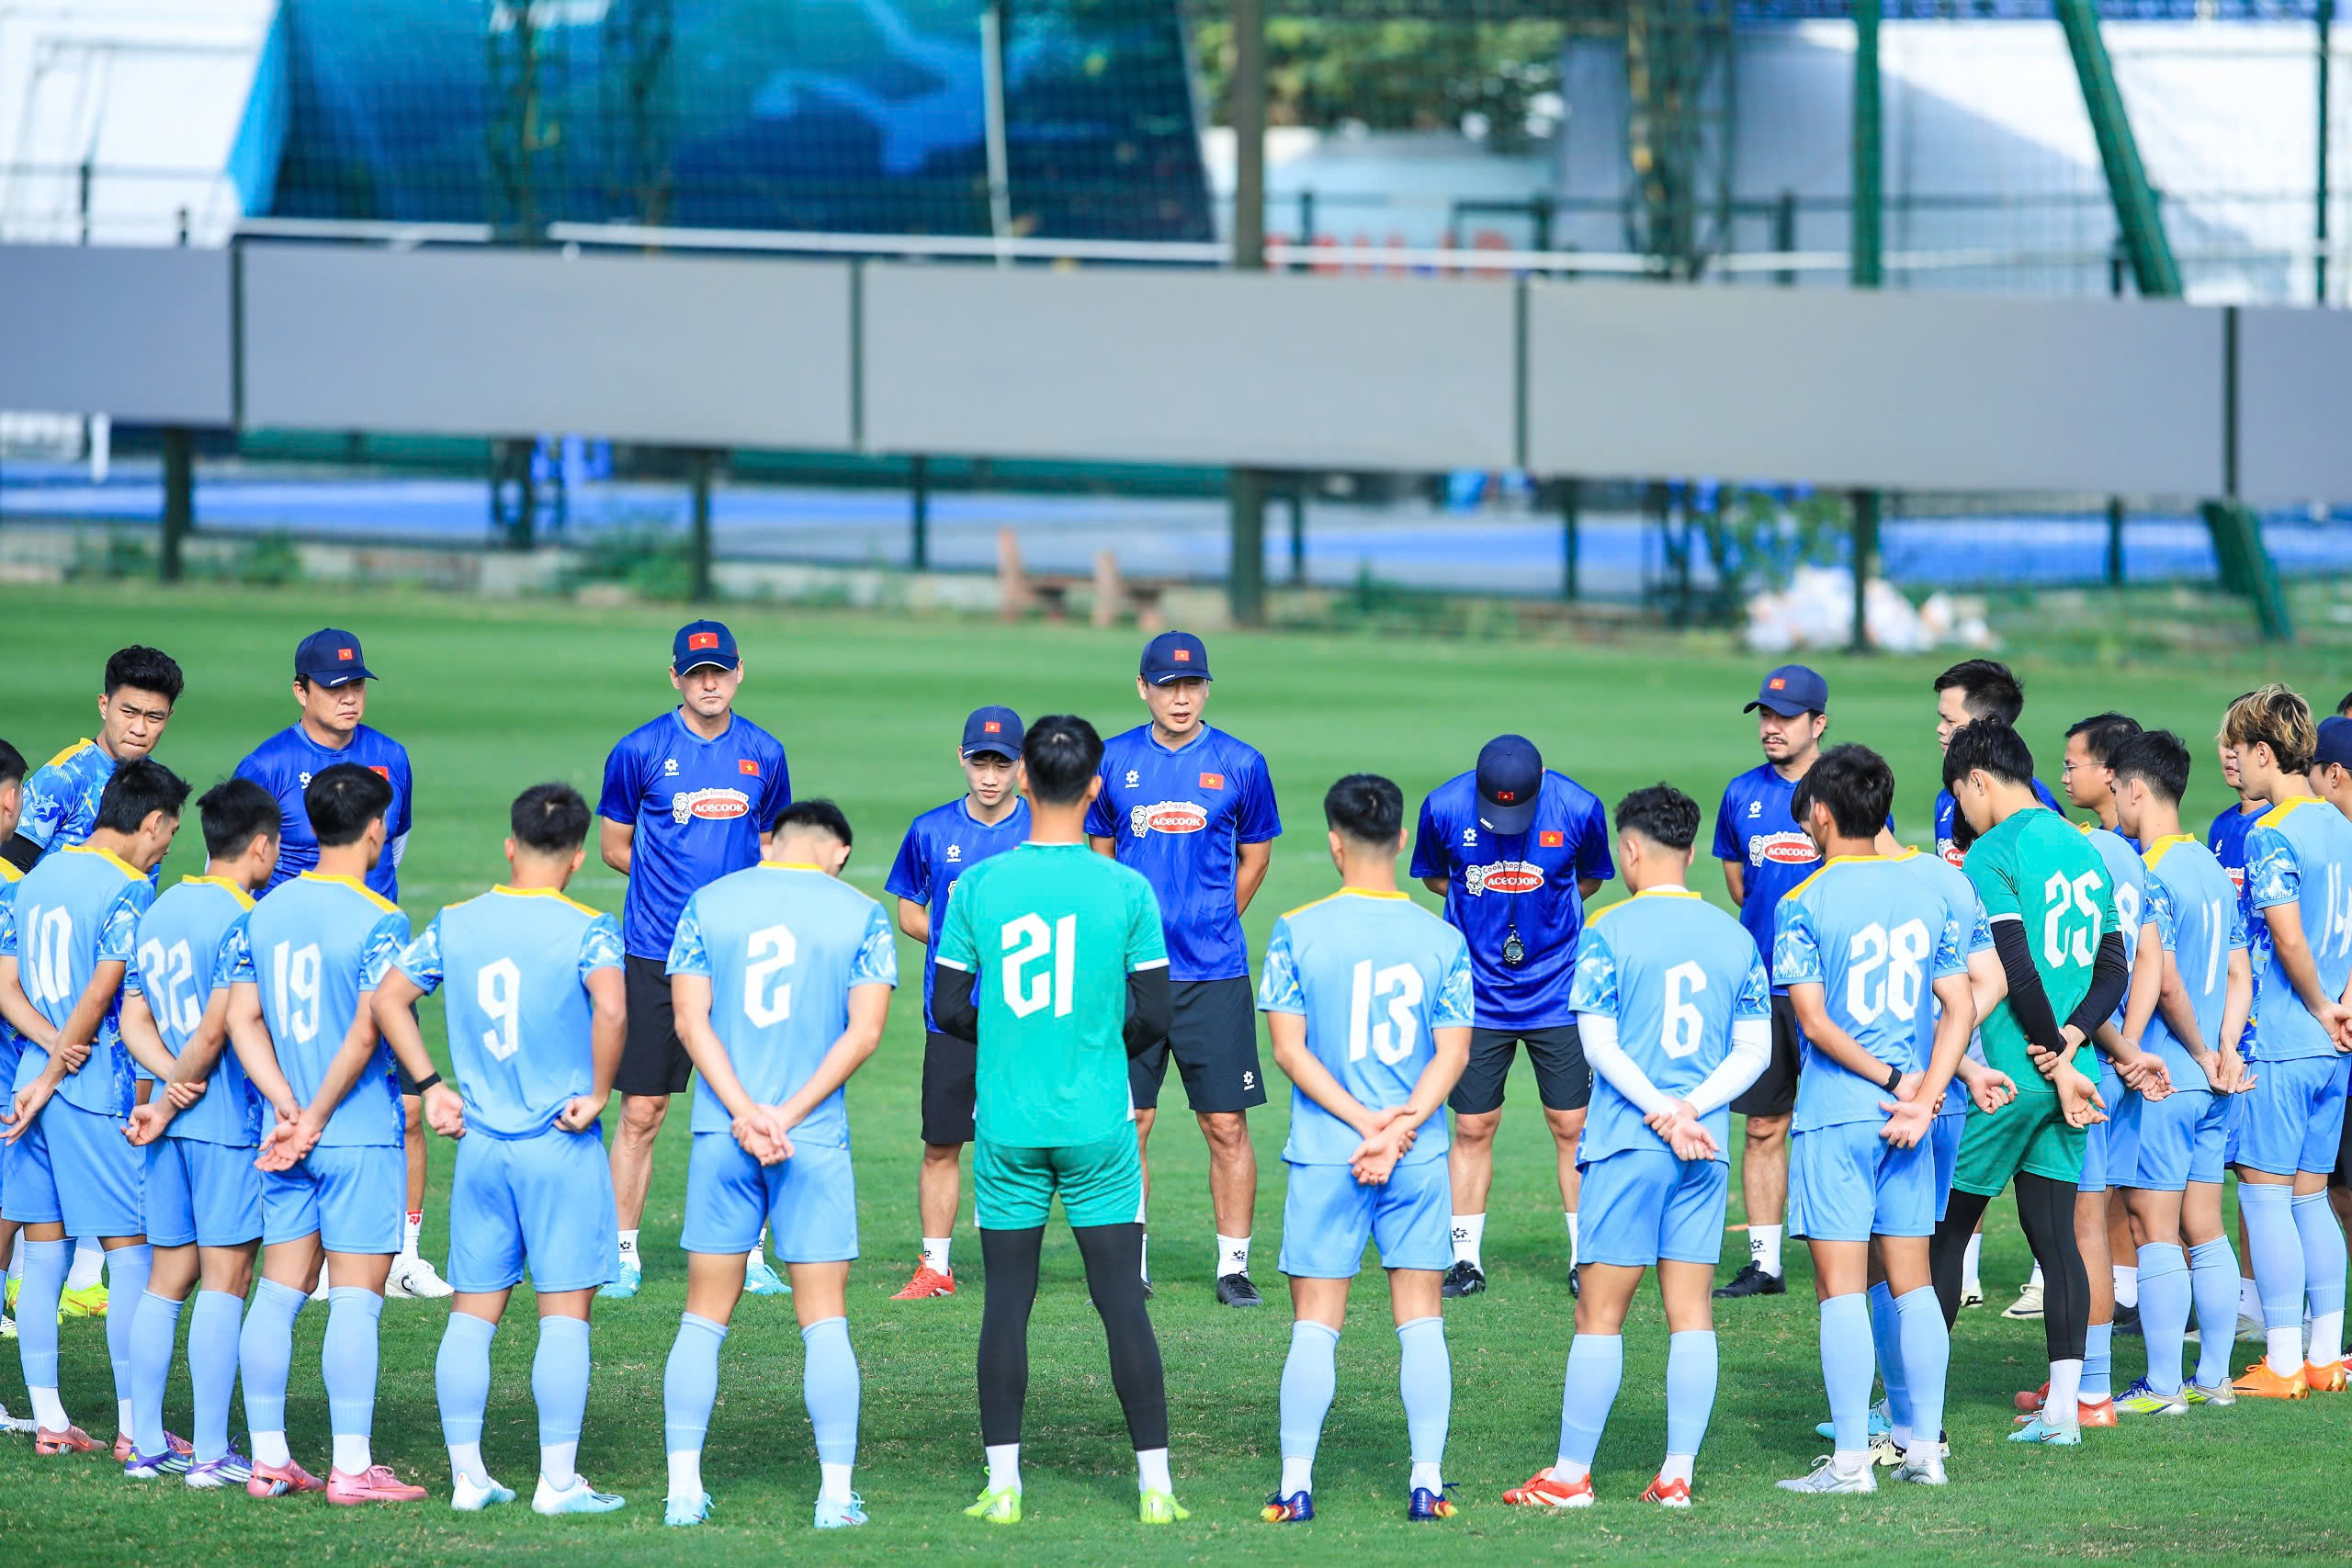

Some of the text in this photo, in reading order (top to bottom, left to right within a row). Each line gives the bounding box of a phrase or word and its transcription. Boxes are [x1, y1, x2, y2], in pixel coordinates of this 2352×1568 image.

[28, 904, 73, 1005] 10
[1001, 912, 1077, 1020] 21
[2044, 869, 2103, 969] 25
[137, 938, 202, 1037] 32
[275, 940, 321, 1044] 19
[477, 957, 520, 1062] 9
[743, 924, 797, 1029] 2
[1349, 960, 1424, 1066] 13
[1659, 961, 1707, 1059] 6
[1847, 919, 1929, 1026] 28
